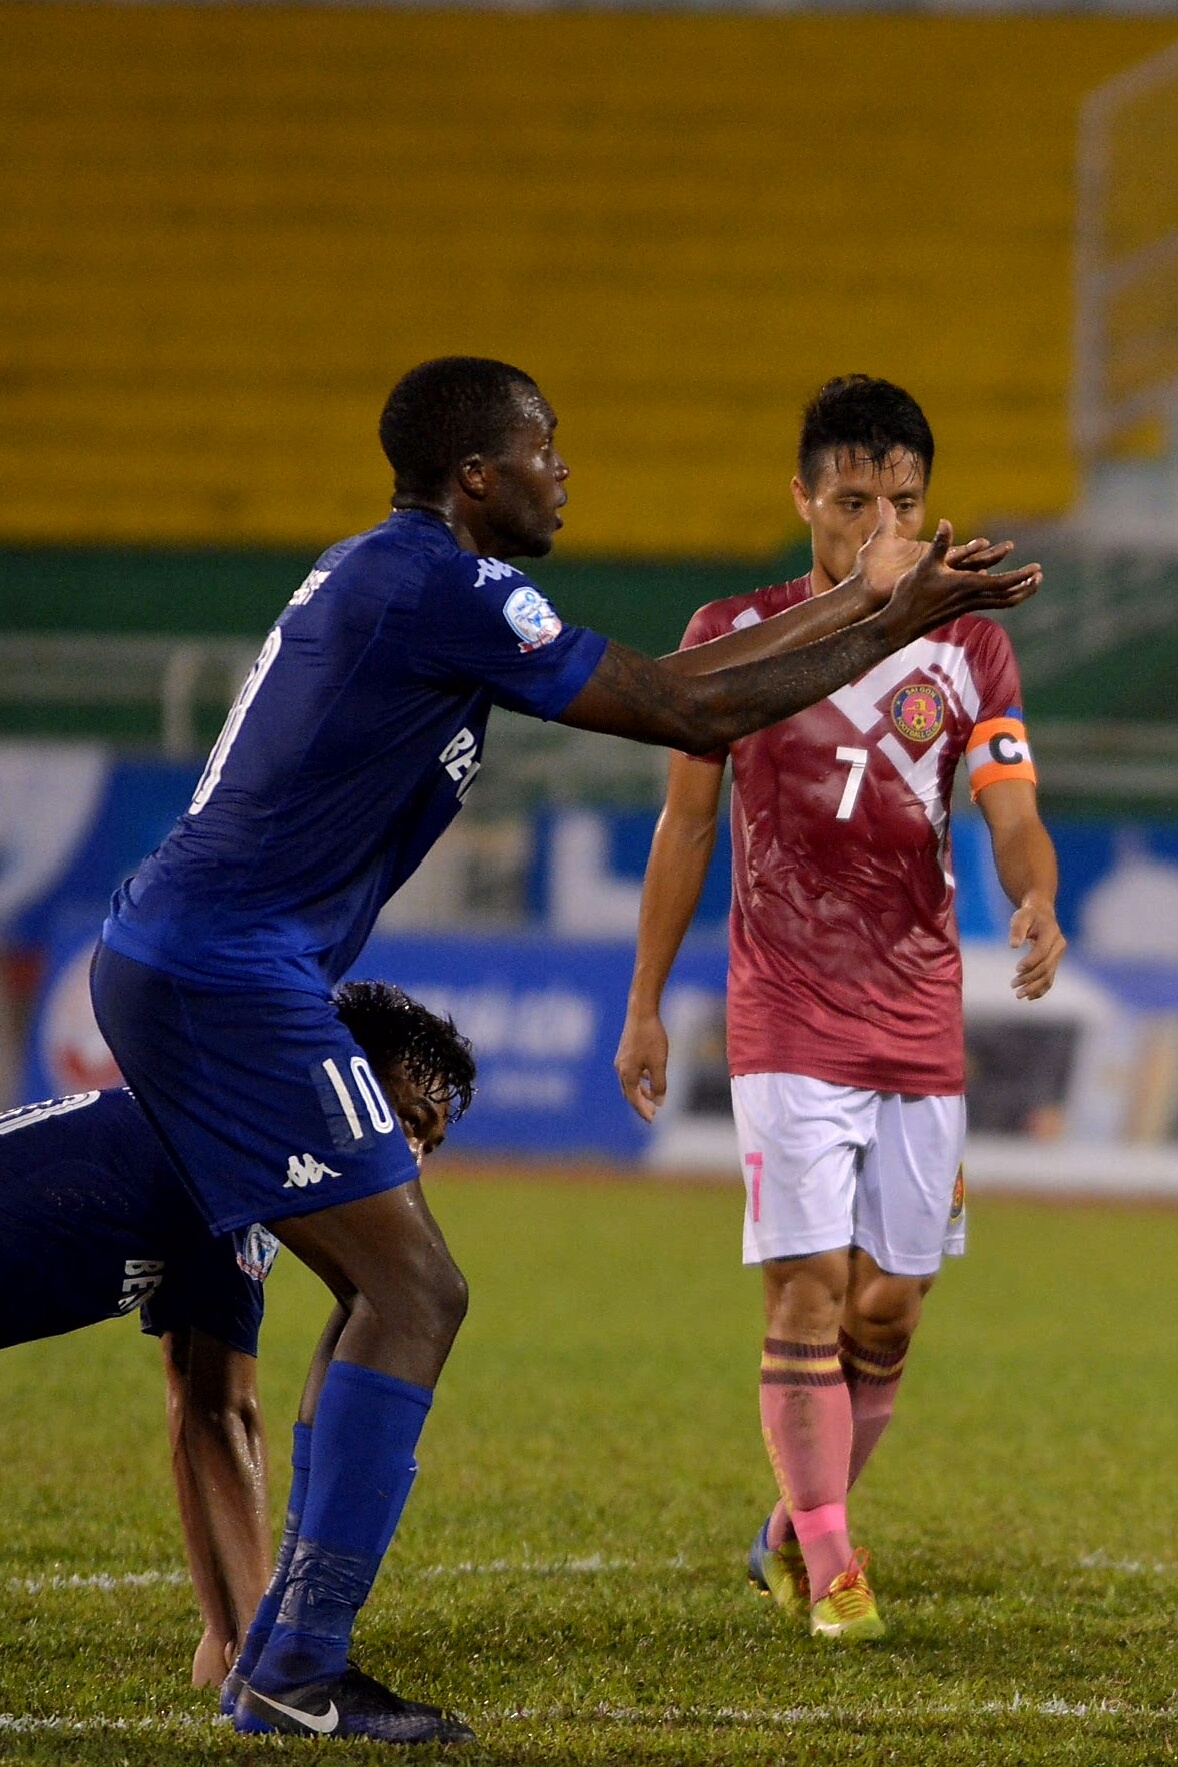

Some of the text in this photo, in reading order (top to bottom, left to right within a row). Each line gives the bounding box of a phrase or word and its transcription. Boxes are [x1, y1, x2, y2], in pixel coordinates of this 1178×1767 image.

[835, 746, 868, 819] 7
[989, 731, 1023, 766] C
[322, 1056, 394, 1139] 10
[744, 1151, 764, 1223] 7
